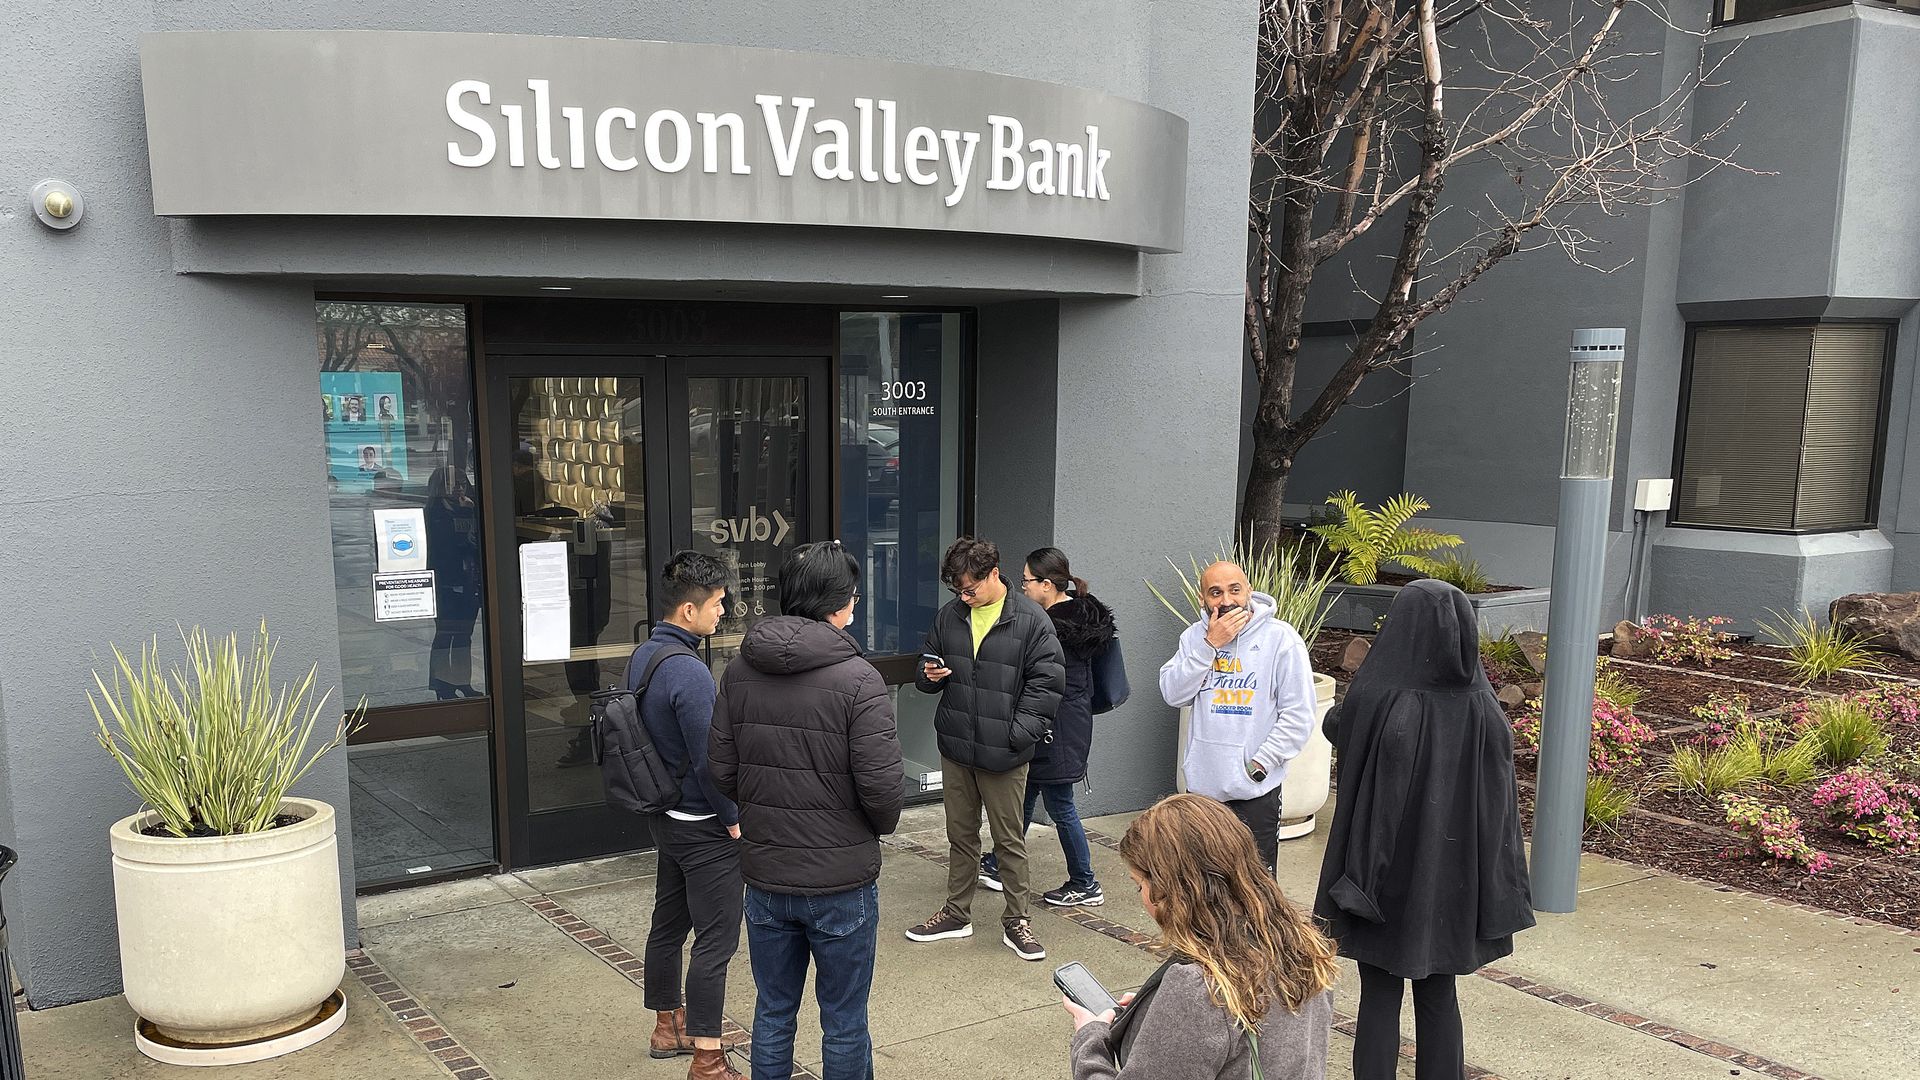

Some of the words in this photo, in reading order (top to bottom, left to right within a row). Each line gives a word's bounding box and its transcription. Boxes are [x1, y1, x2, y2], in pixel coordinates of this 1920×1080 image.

[445, 79, 750, 175] Silicon
[755, 94, 981, 207] Valley
[986, 114, 1111, 201] Bank
[626, 308, 708, 343] 3003
[881, 381, 926, 400] 3003
[872, 407, 897, 416] SOUTH
[898, 406, 935, 415] ENTRANCE
[750, 561, 767, 569] Lobby
[1212, 689, 1255, 705] 2017
